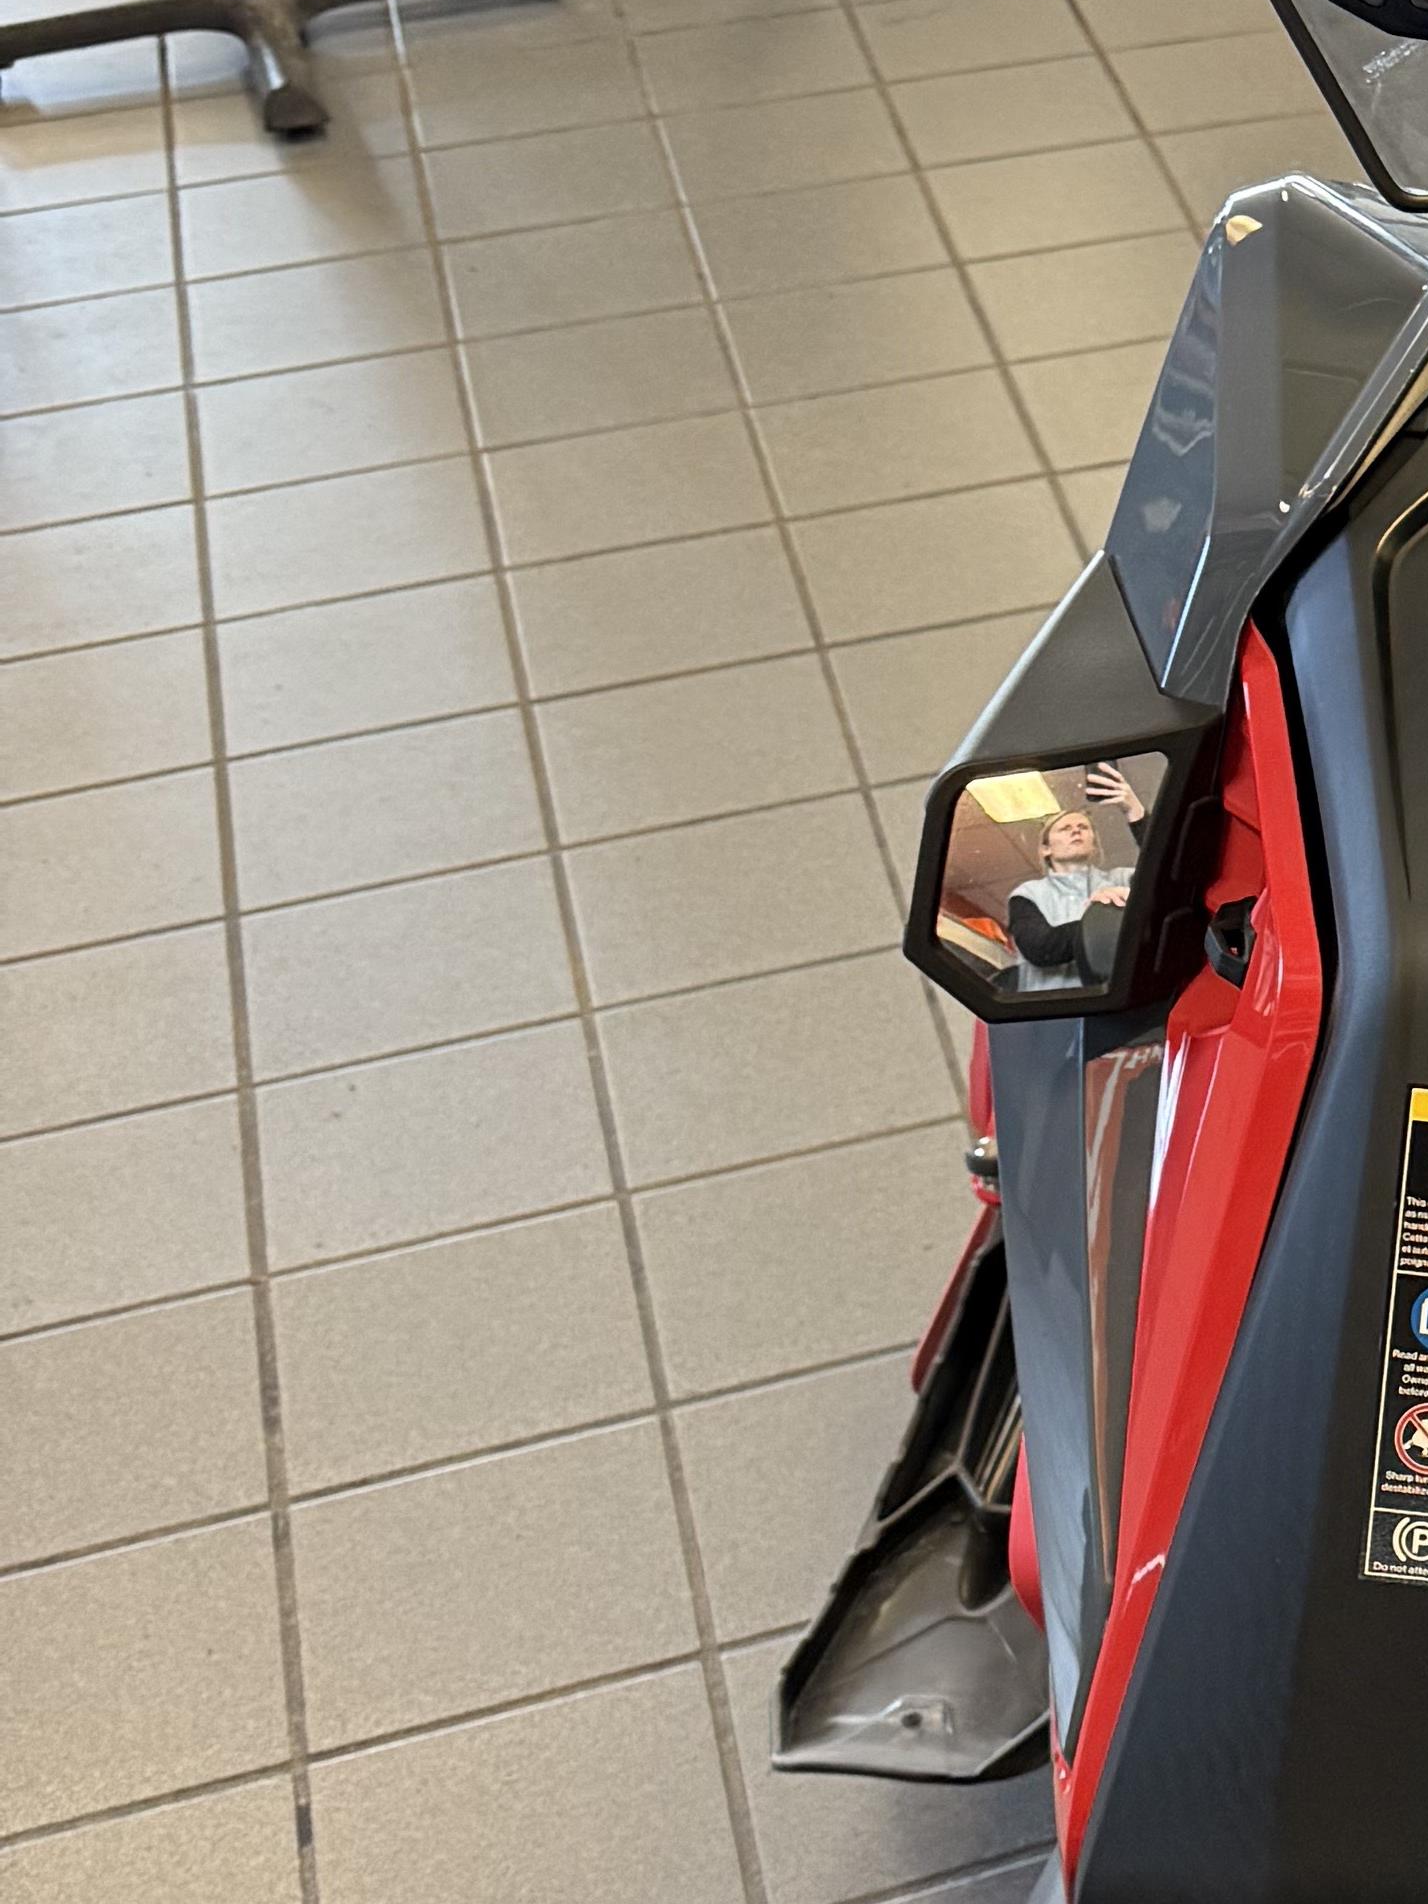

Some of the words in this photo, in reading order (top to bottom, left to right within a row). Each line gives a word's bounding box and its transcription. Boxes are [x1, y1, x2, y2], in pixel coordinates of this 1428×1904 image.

[1407, 1196, 1426, 1208] This
[1403, 1232, 1428, 1243] Cette
[1401, 1245, 1411, 1253] et
[1392, 1349, 1418, 1360] Read
[1385, 1470, 1414, 1483] Sharp
[1373, 1561, 1389, 1571] Do
[1389, 1564, 1407, 1574] not
